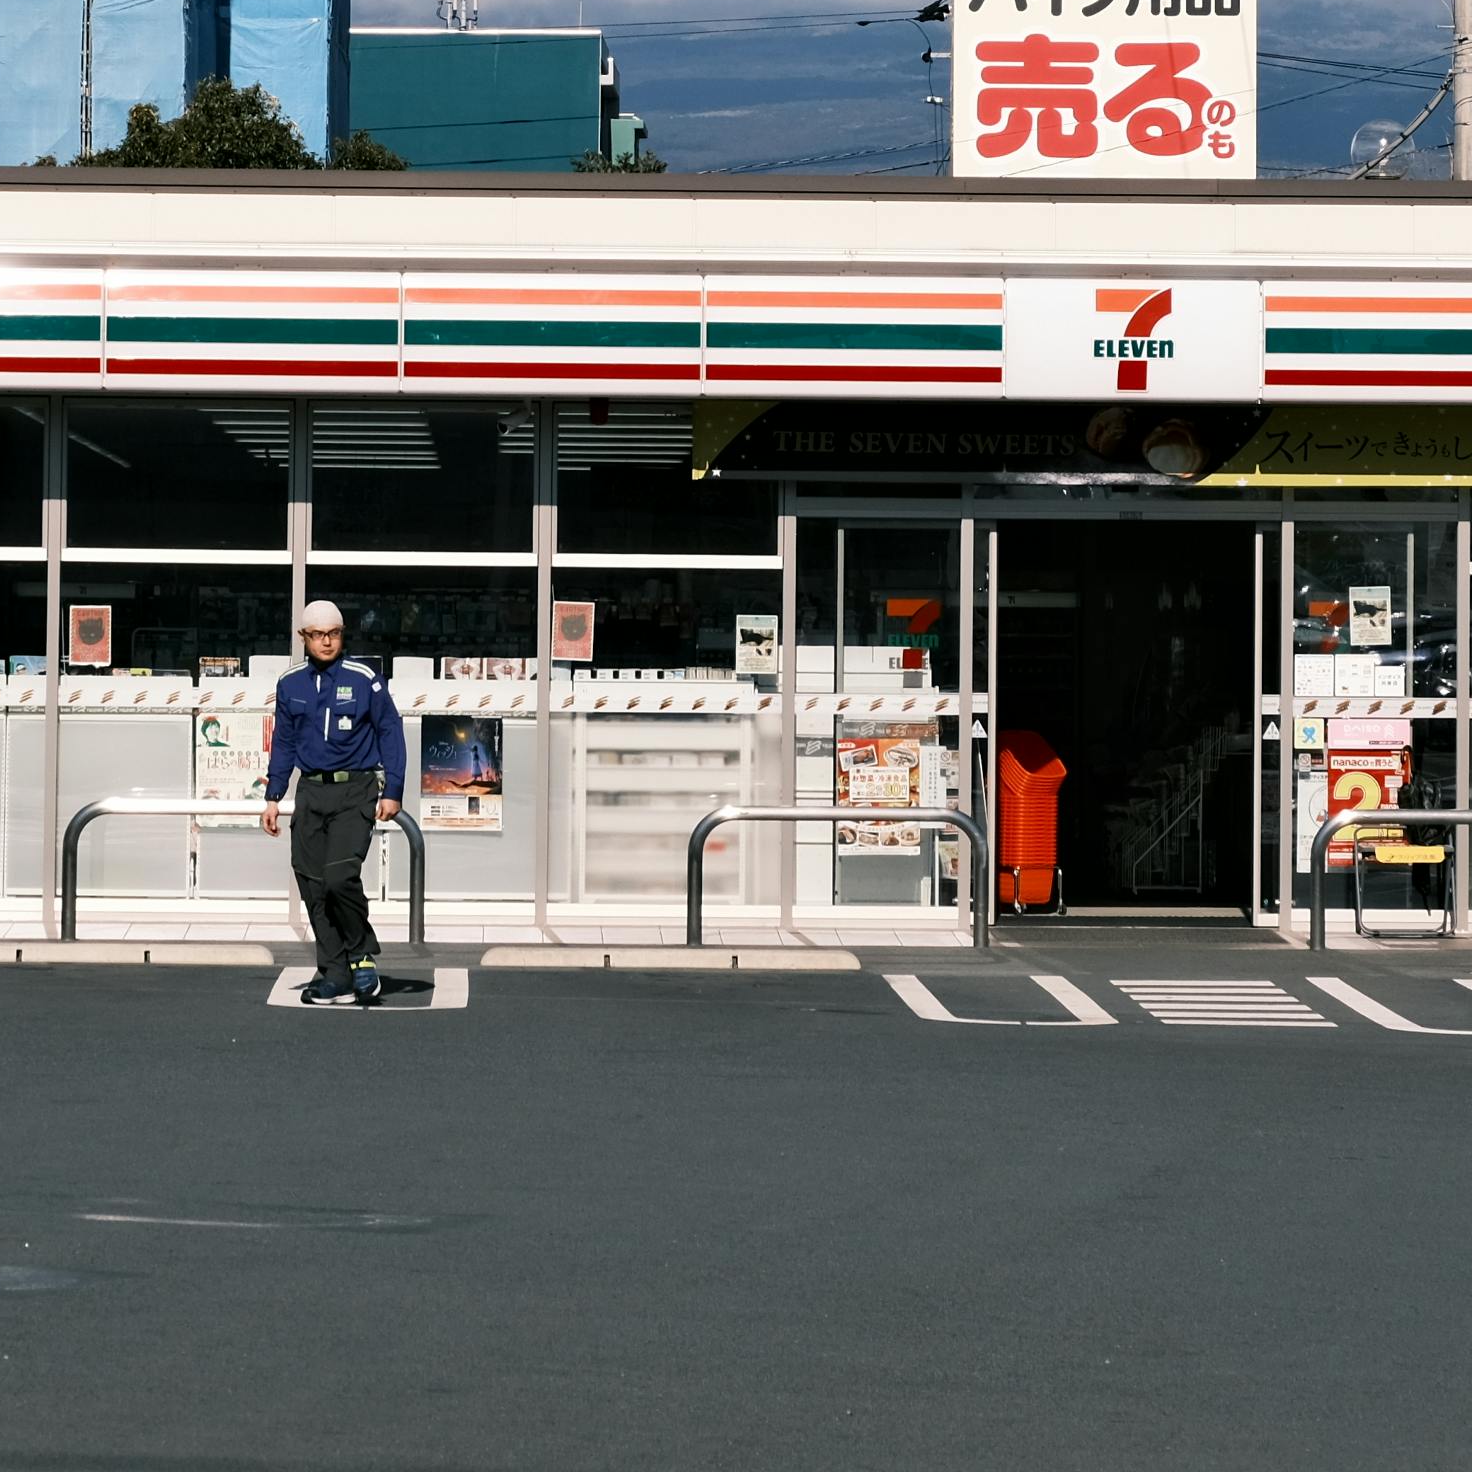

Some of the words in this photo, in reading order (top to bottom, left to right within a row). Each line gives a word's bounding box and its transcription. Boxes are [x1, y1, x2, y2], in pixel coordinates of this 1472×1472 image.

[1093, 339, 1174, 359] ELEVEN
[774, 431, 835, 452] THE
[849, 432, 947, 454] SEVEN
[958, 433, 1075, 456] SWEETS
